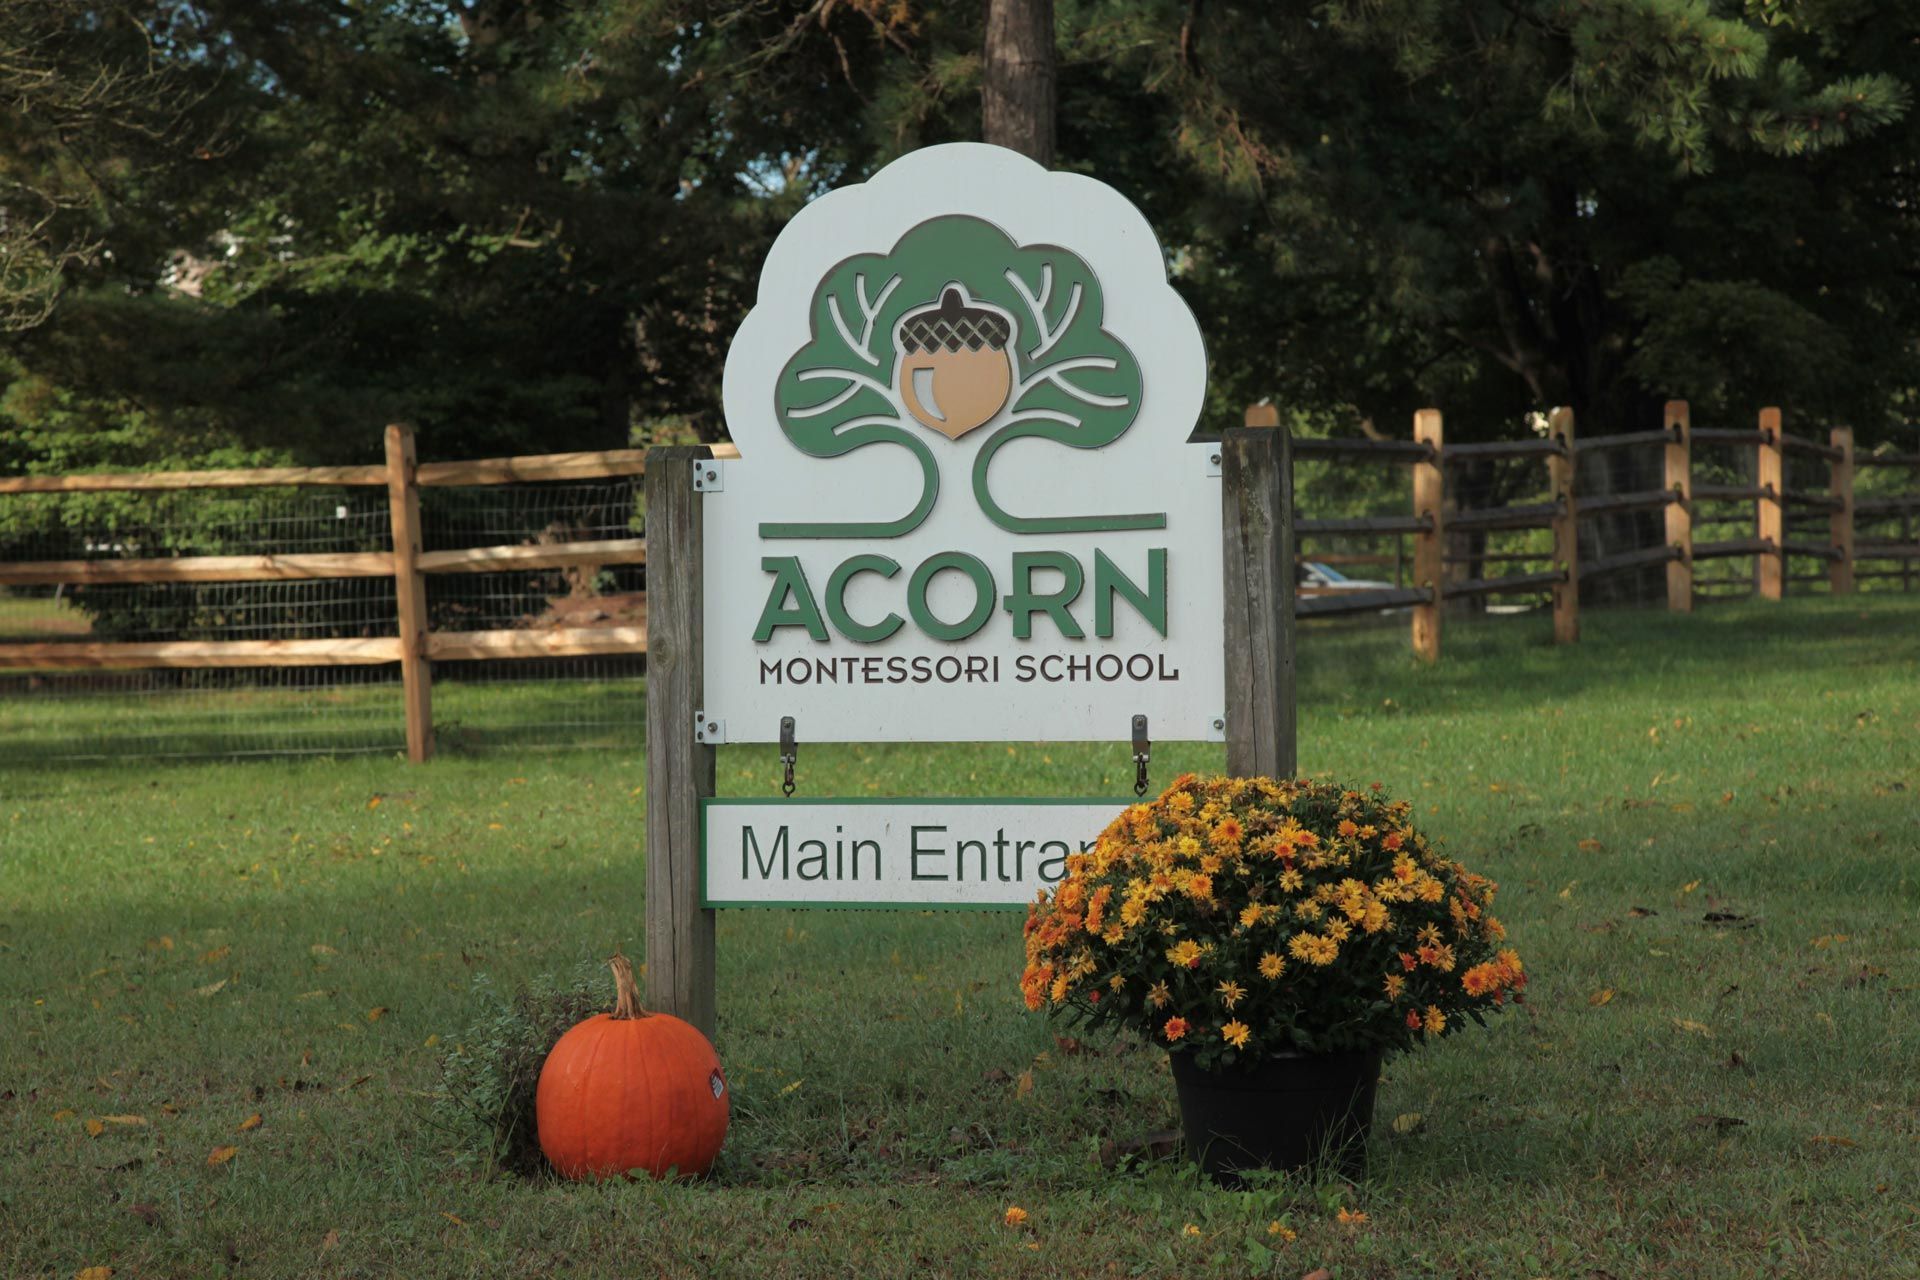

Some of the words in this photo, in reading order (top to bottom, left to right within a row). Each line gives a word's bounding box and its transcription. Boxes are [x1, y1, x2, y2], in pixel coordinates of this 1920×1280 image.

[752, 548, 1168, 645] ACORN
[760, 656, 999, 685] MONTESSORI
[1015, 654, 1179, 683] SCHOOL
[742, 826, 882, 881] Main
[911, 826, 1098, 882] Entra
